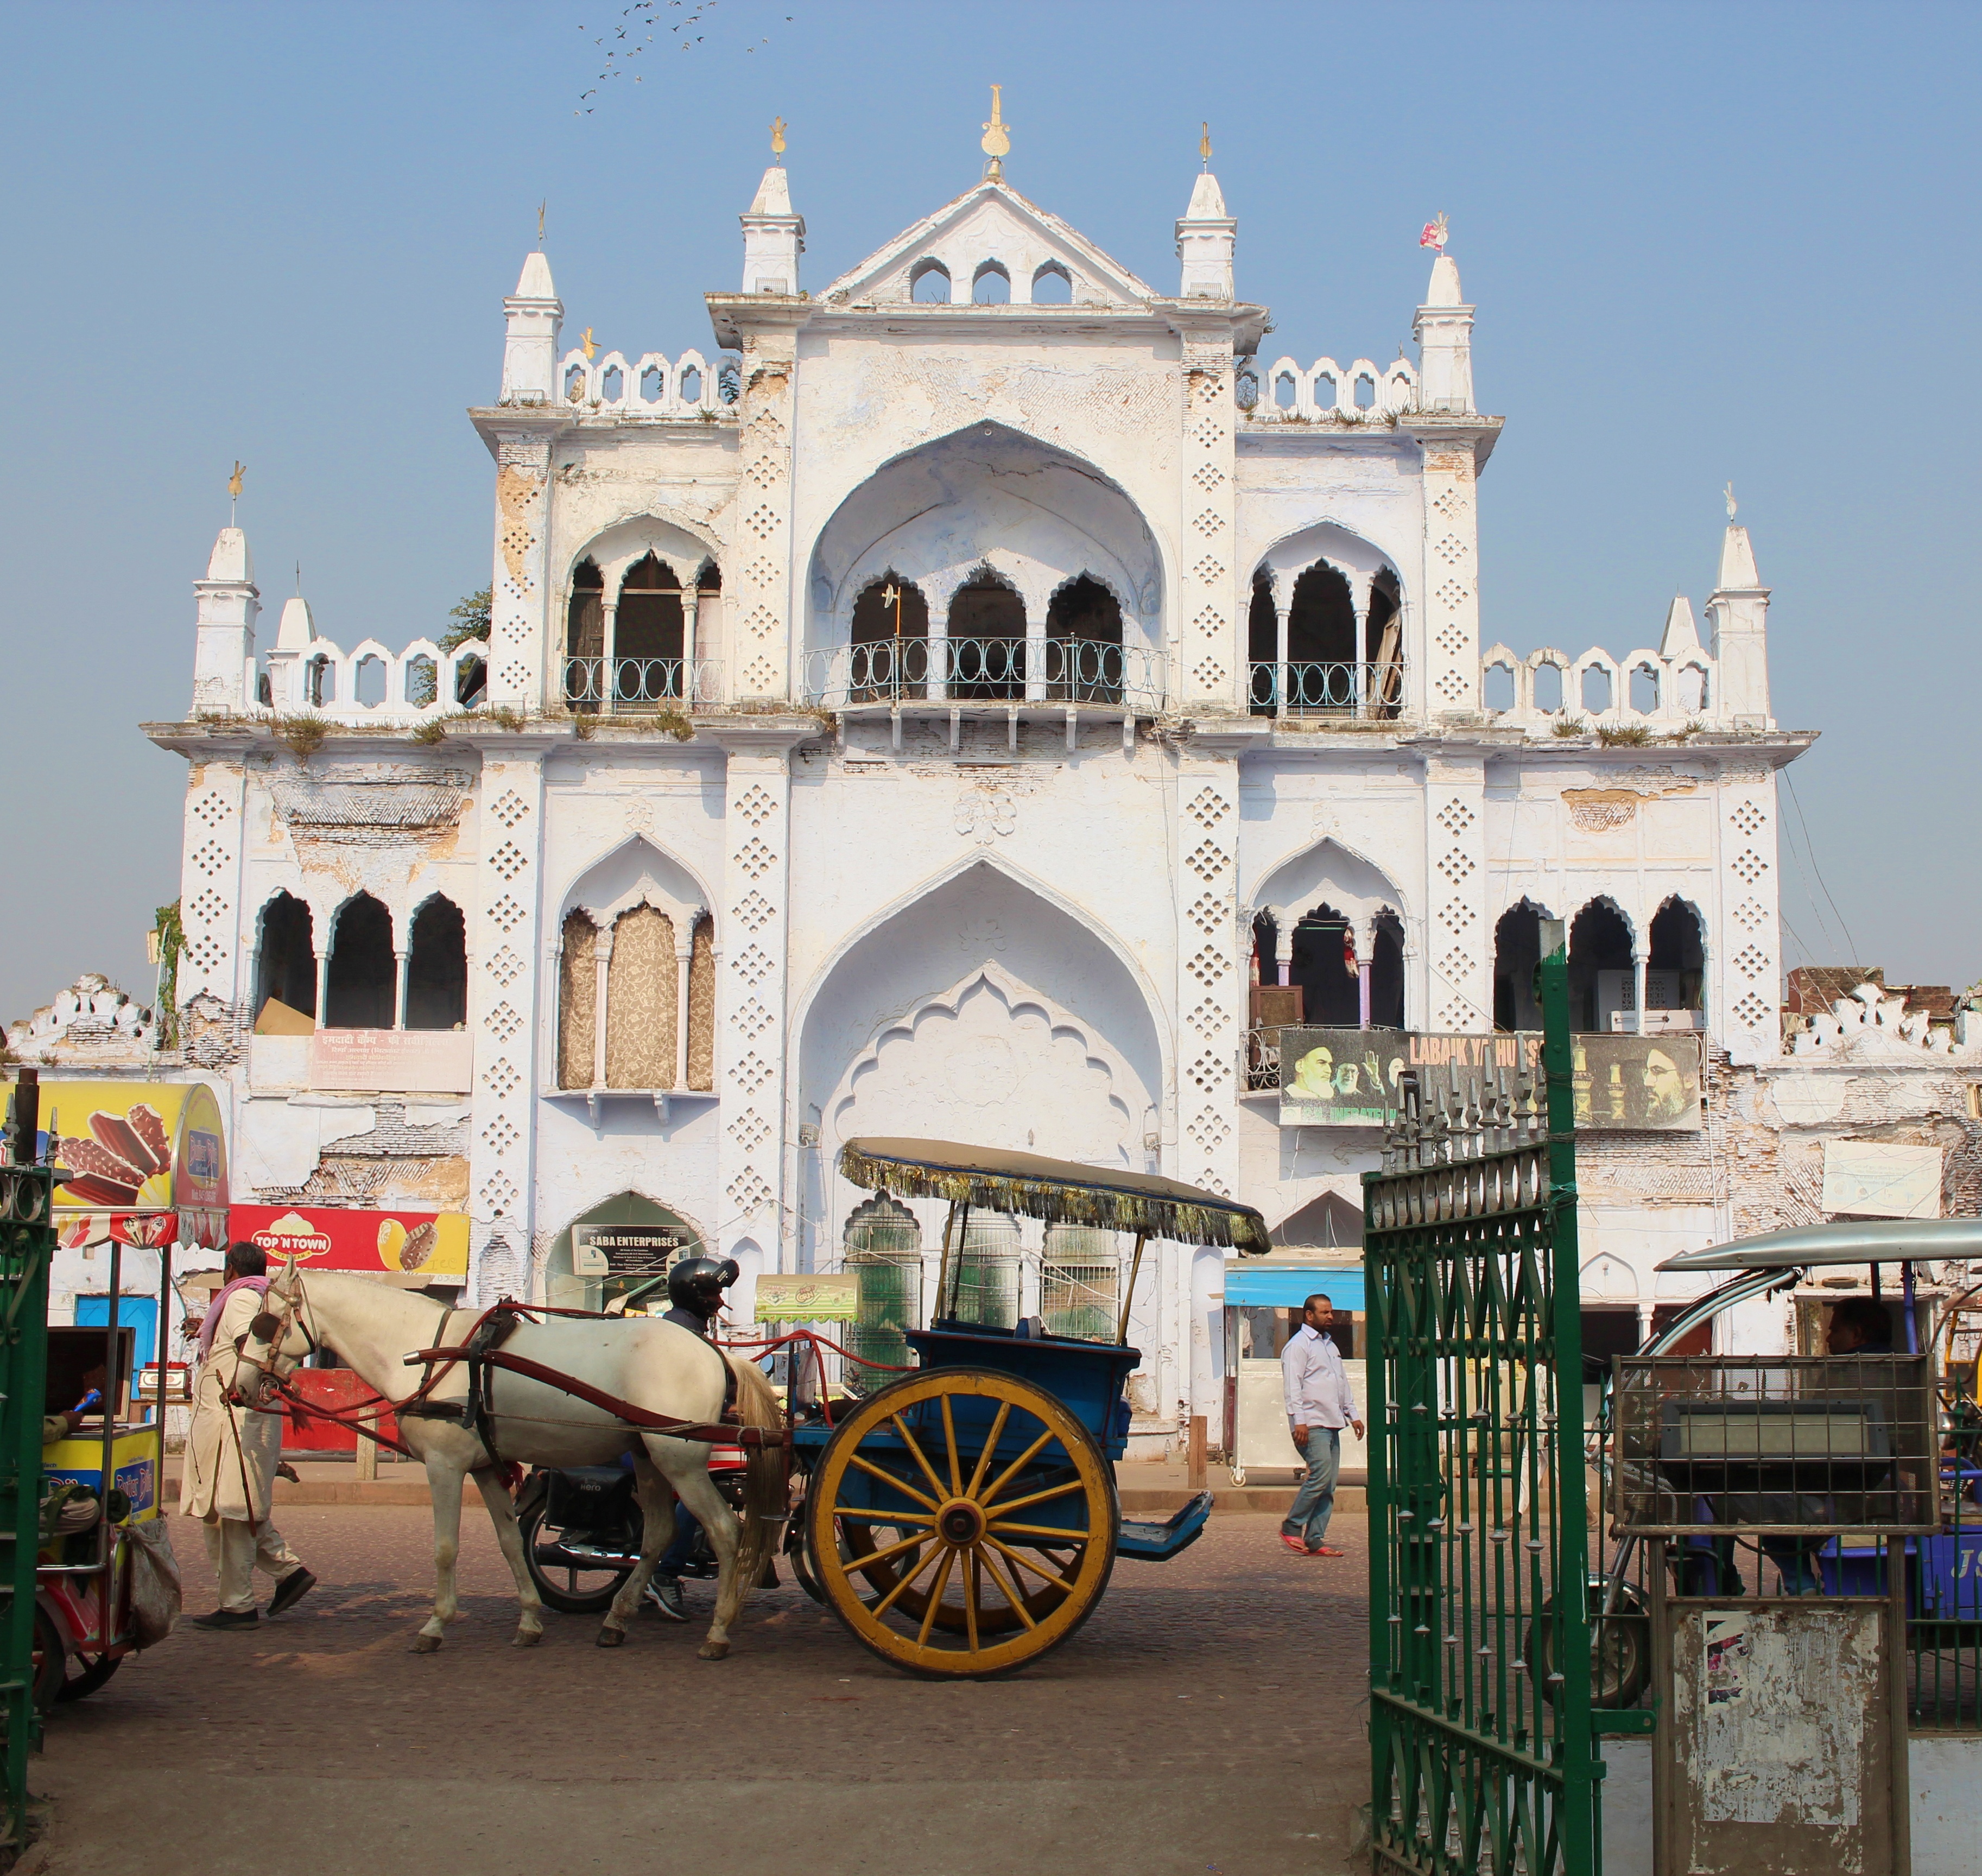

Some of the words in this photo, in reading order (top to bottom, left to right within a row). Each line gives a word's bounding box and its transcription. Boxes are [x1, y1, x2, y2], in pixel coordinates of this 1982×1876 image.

[322, 1035, 354, 1045] इमदादी
[1409, 1036, 1467, 1065] LABAIK
[256, 1237, 278, 1248] TOP
[292, 1238, 327, 1250] TOWN
[590, 1236, 616, 1246] SABA
[617, 1237, 679, 1247] ENTERPRISES
[800, 1284, 816, 1294] HOT
[796, 1290, 814, 1303] CORN
